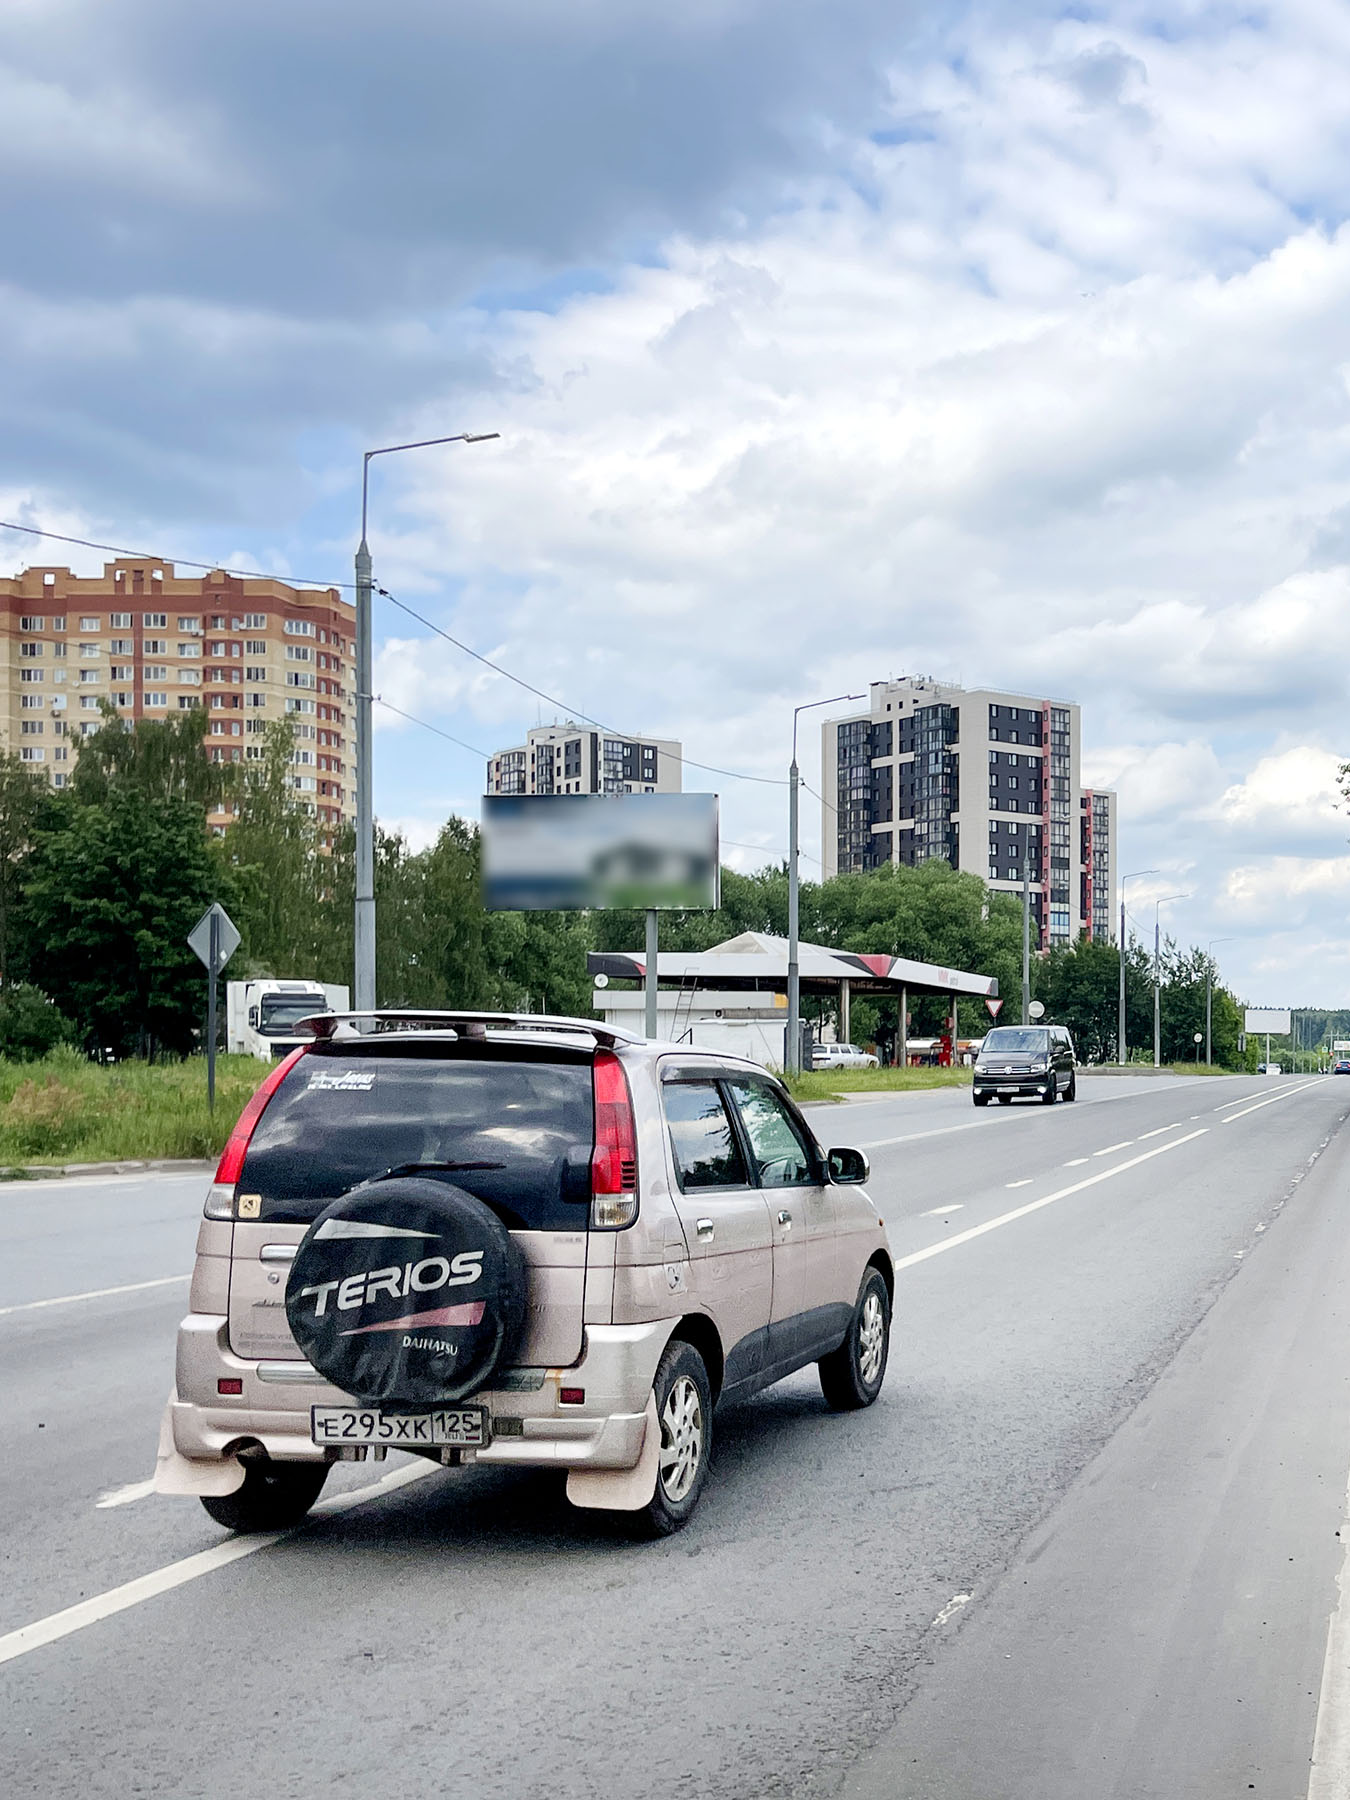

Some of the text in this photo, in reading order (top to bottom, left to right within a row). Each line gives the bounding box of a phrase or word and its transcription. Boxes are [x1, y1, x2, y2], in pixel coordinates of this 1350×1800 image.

[301, 1250, 484, 1317] TERIOS
[402, 1335, 458, 1357] DAIHATSU
[324, 1413, 474, 1438] Е295ХК 125
